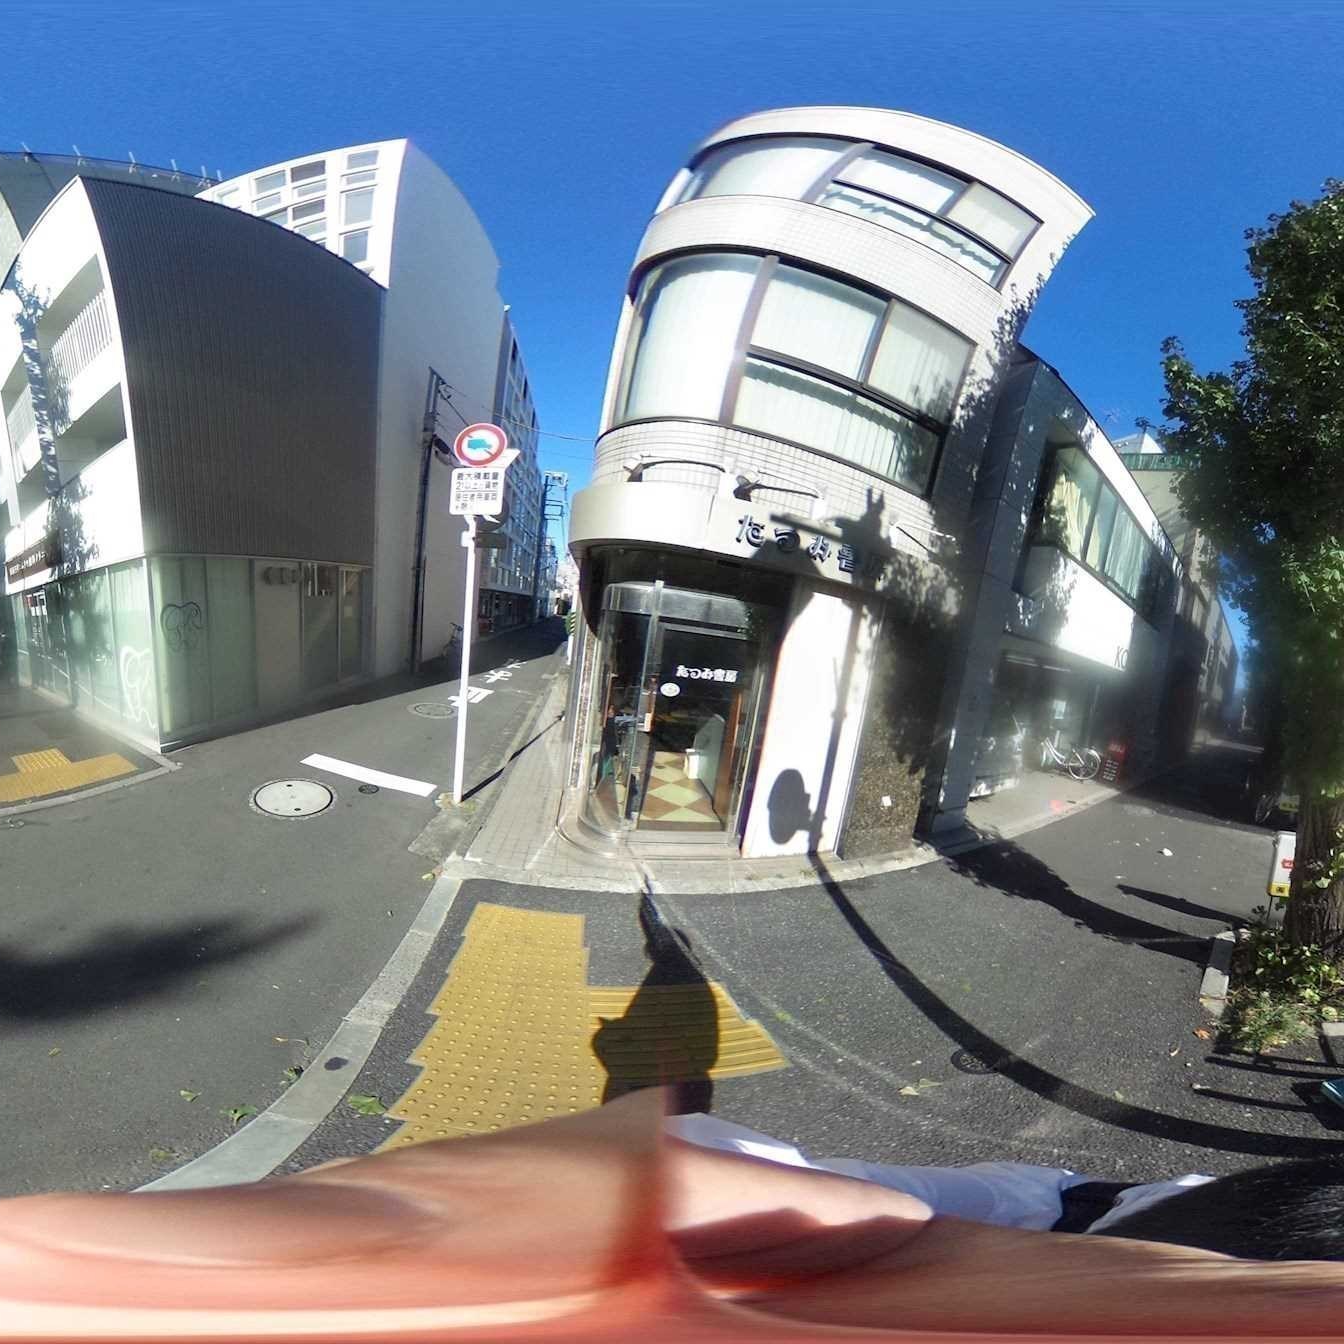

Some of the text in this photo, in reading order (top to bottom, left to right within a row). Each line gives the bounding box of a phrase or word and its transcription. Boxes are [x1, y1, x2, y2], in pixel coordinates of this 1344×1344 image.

[675, 664, 739, 683] たつみ書房
